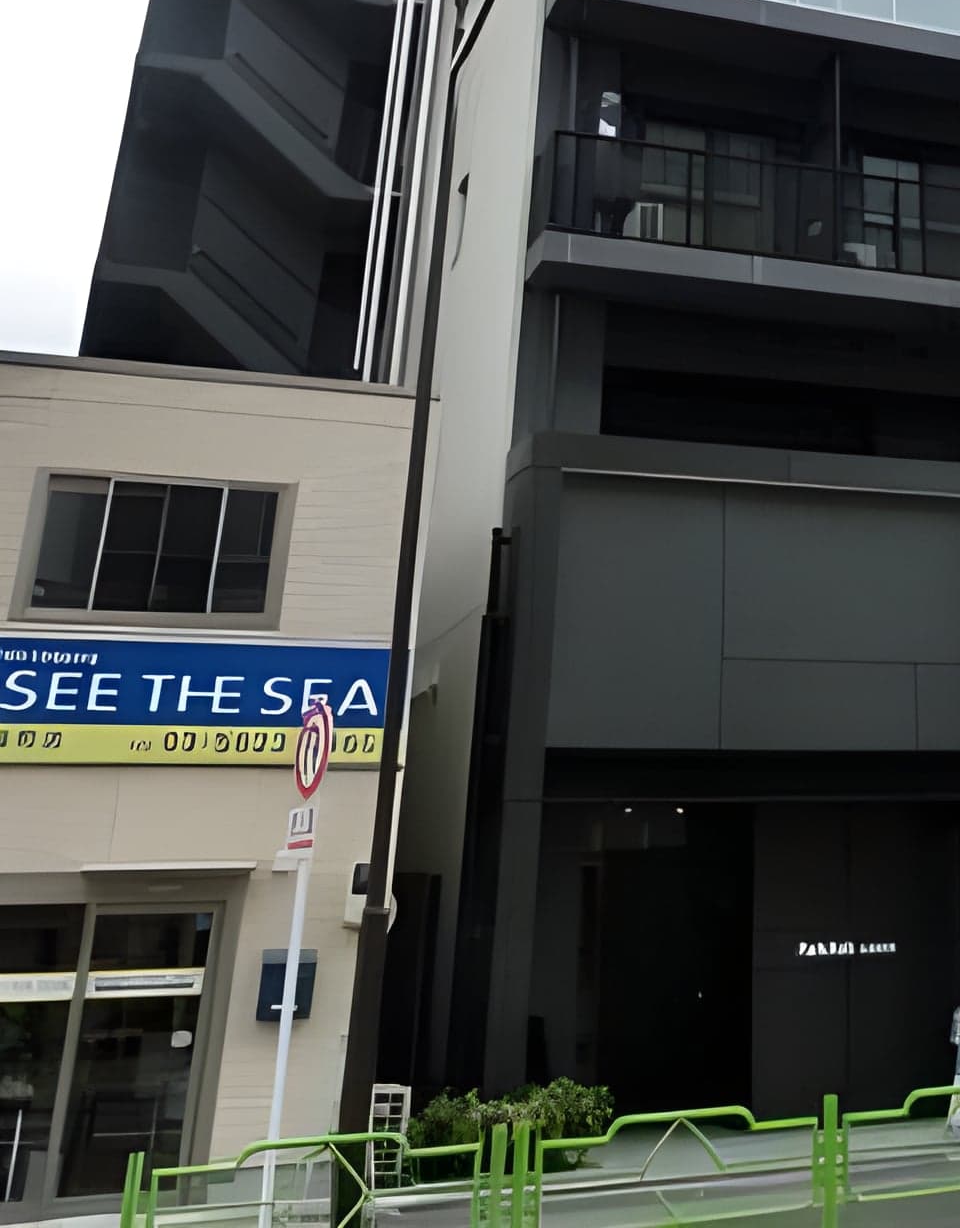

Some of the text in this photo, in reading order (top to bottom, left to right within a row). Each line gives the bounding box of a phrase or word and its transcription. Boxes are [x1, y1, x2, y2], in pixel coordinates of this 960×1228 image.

[0, 670, 378, 716] SEE THE SEA
